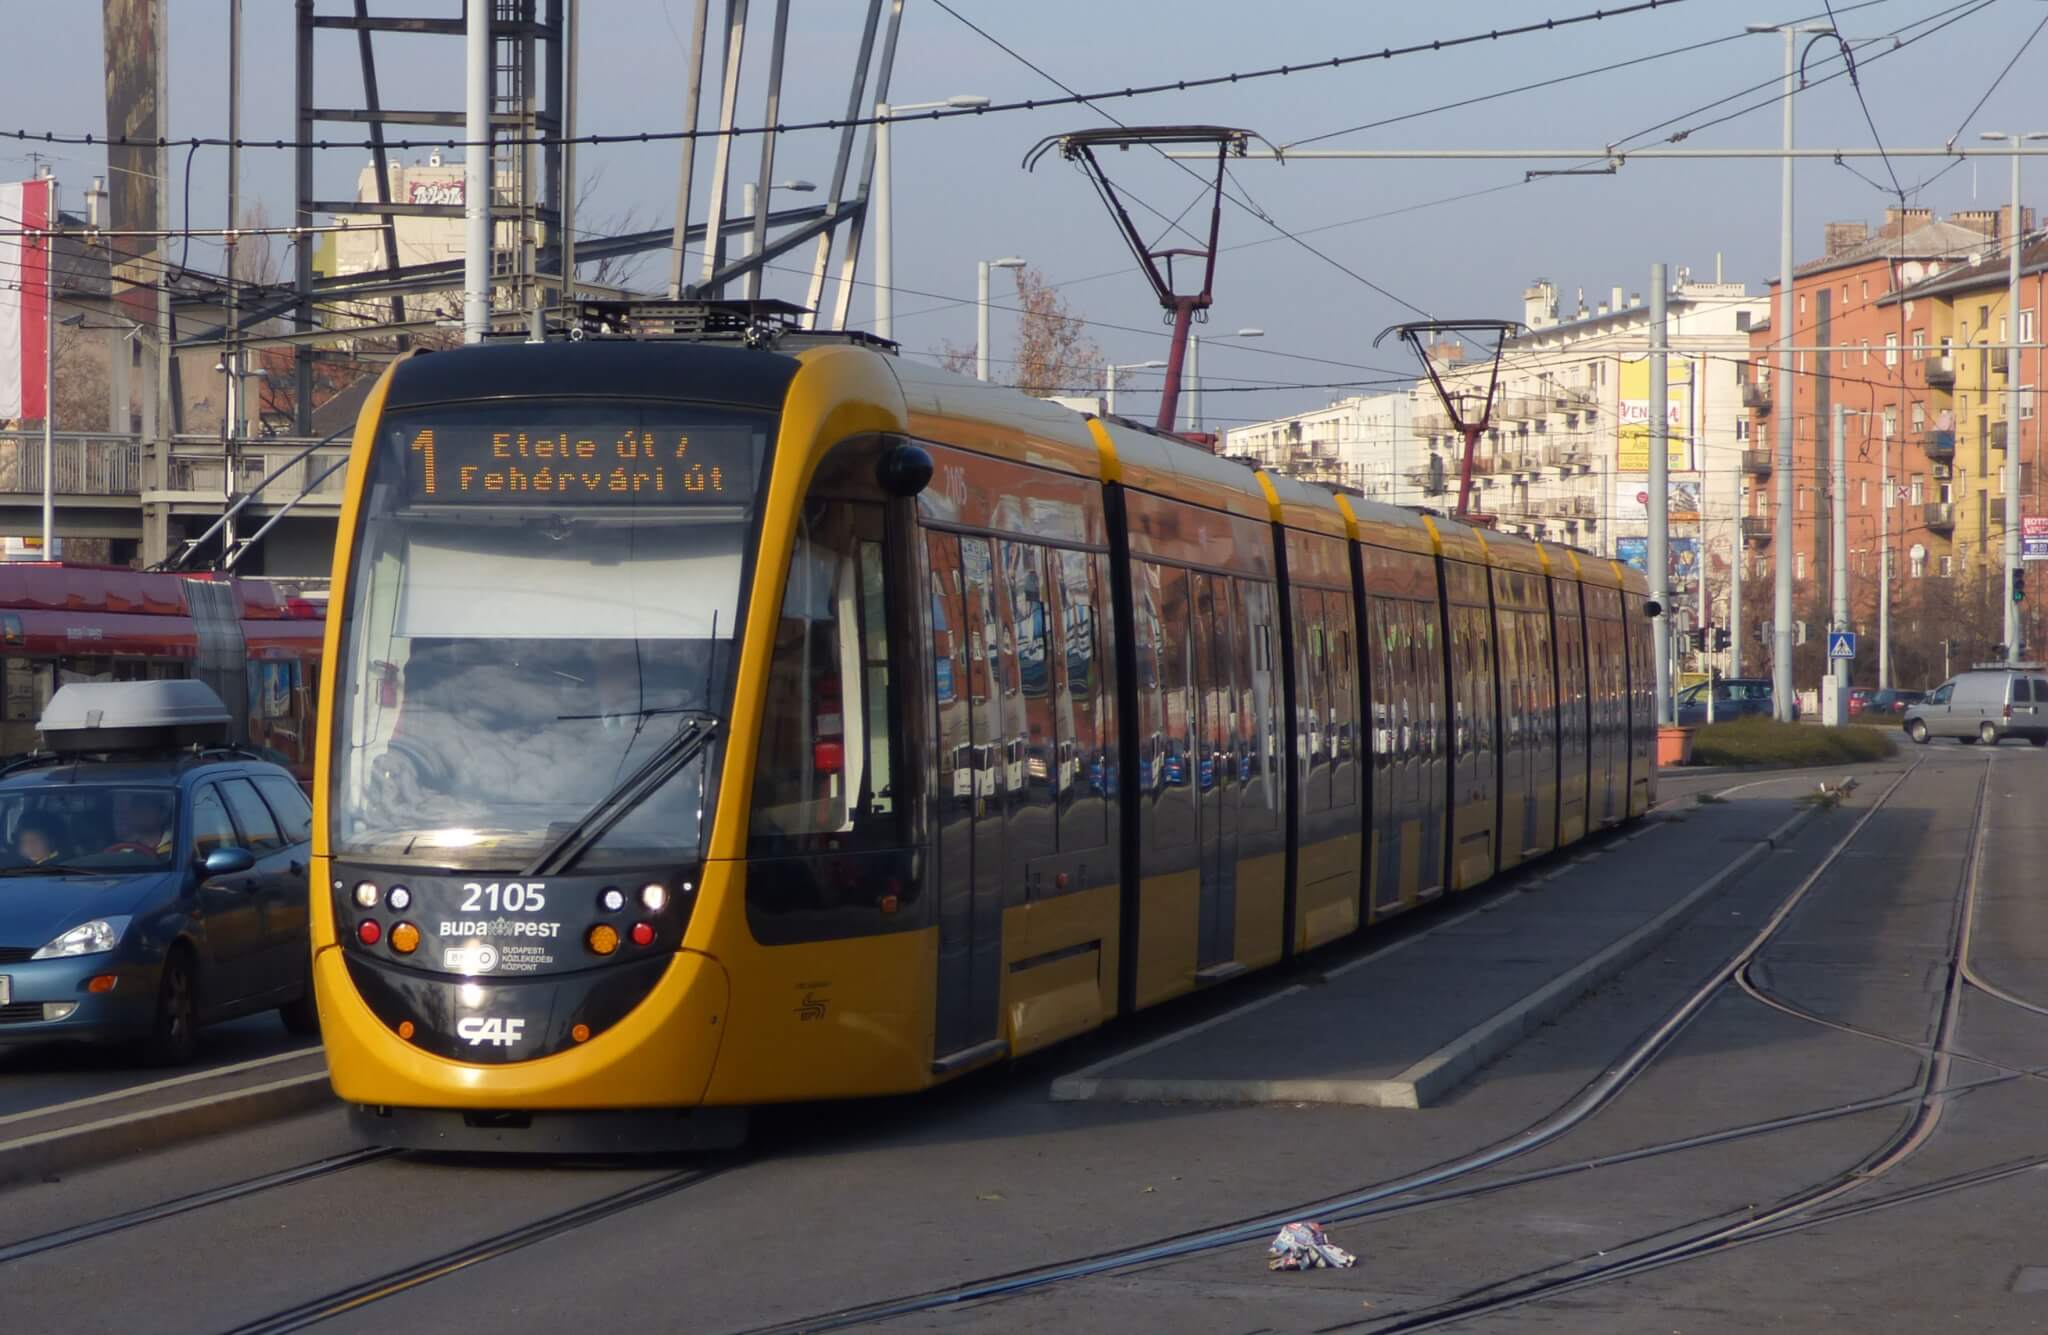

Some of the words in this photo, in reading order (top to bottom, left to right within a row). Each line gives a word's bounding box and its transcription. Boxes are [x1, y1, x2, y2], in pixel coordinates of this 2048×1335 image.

[493, 432, 596, 457] Etele
[616, 430, 655, 457] út
[410, 429, 435, 494] 1
[460, 465, 665, 491] Fehérvári
[684, 463, 723, 491] út
[461, 882, 546, 911] 2105
[502, 945, 545, 955] BUDAPESTI
[457, 1017, 525, 1046] CAF
